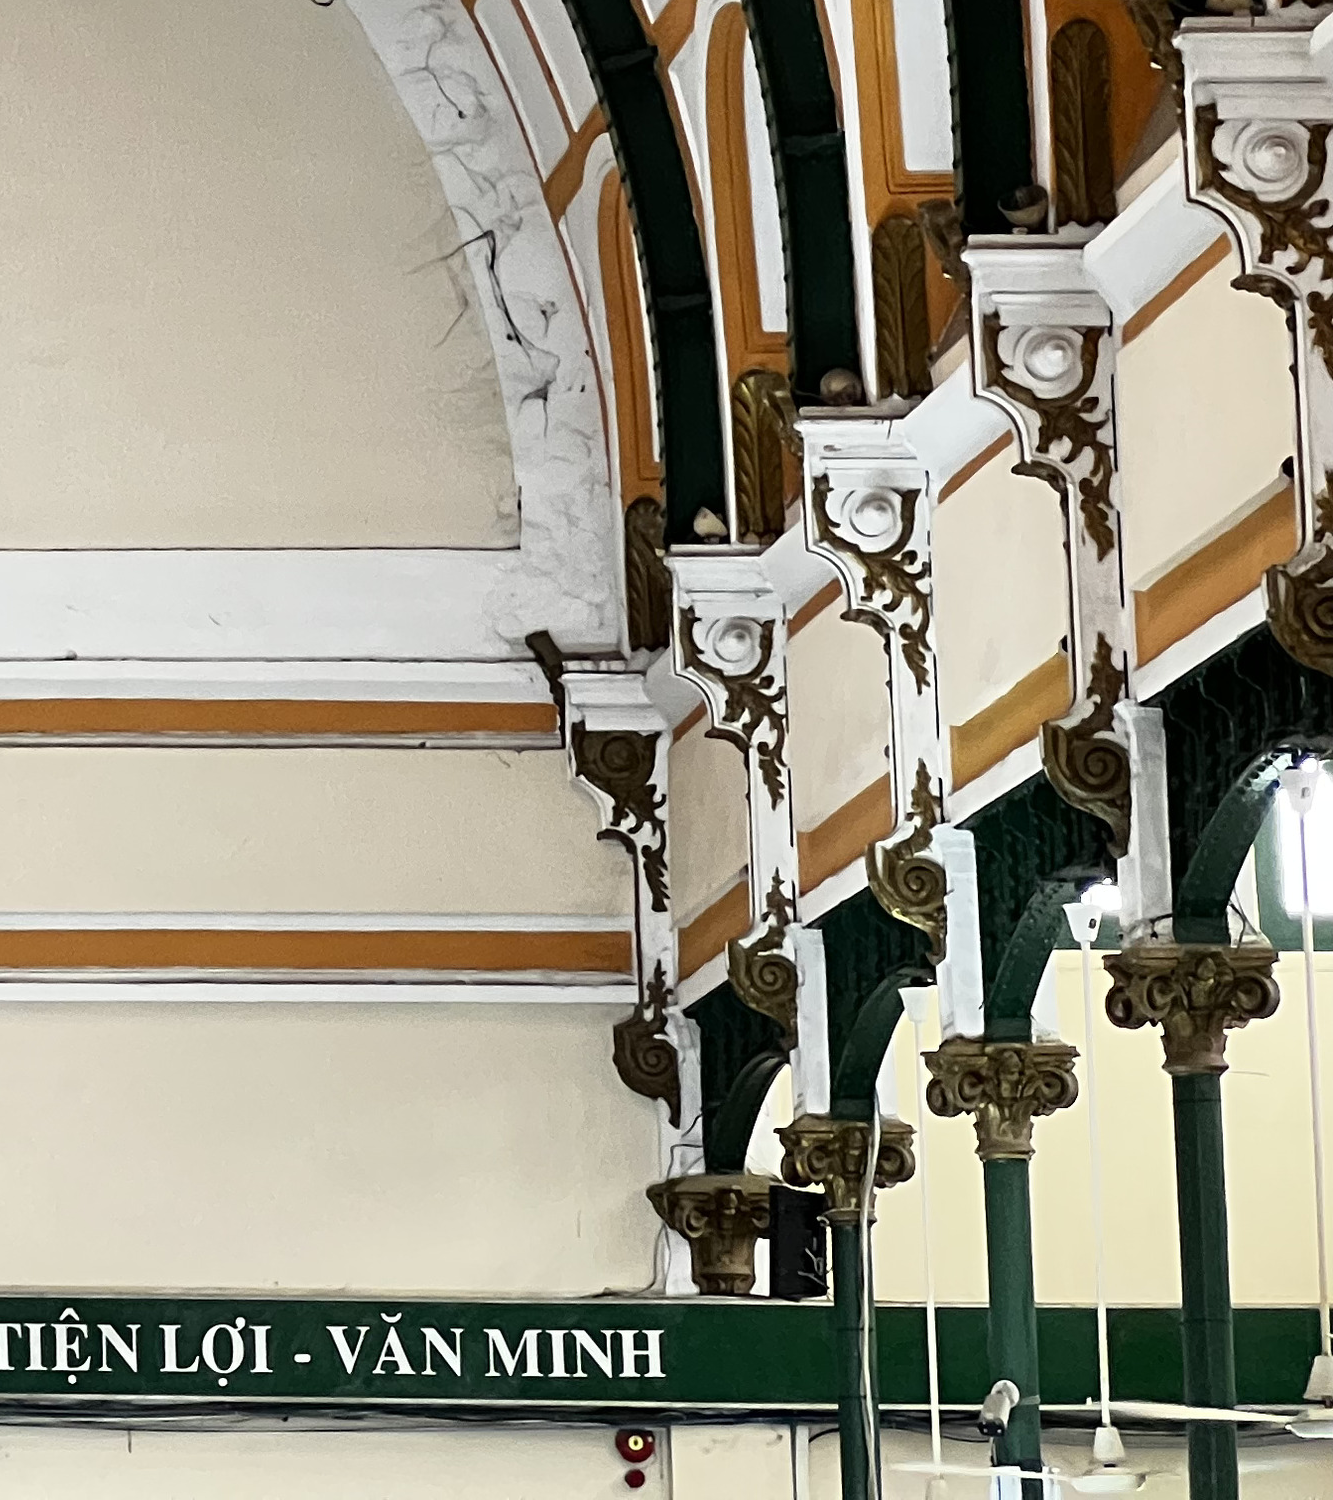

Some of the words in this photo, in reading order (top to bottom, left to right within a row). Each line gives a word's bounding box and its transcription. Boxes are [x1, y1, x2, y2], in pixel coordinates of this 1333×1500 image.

[158, 1316, 274, 1387] LỢI
[326, 1312, 465, 1377] VĂN
[484, 1328, 667, 1379] MINH
